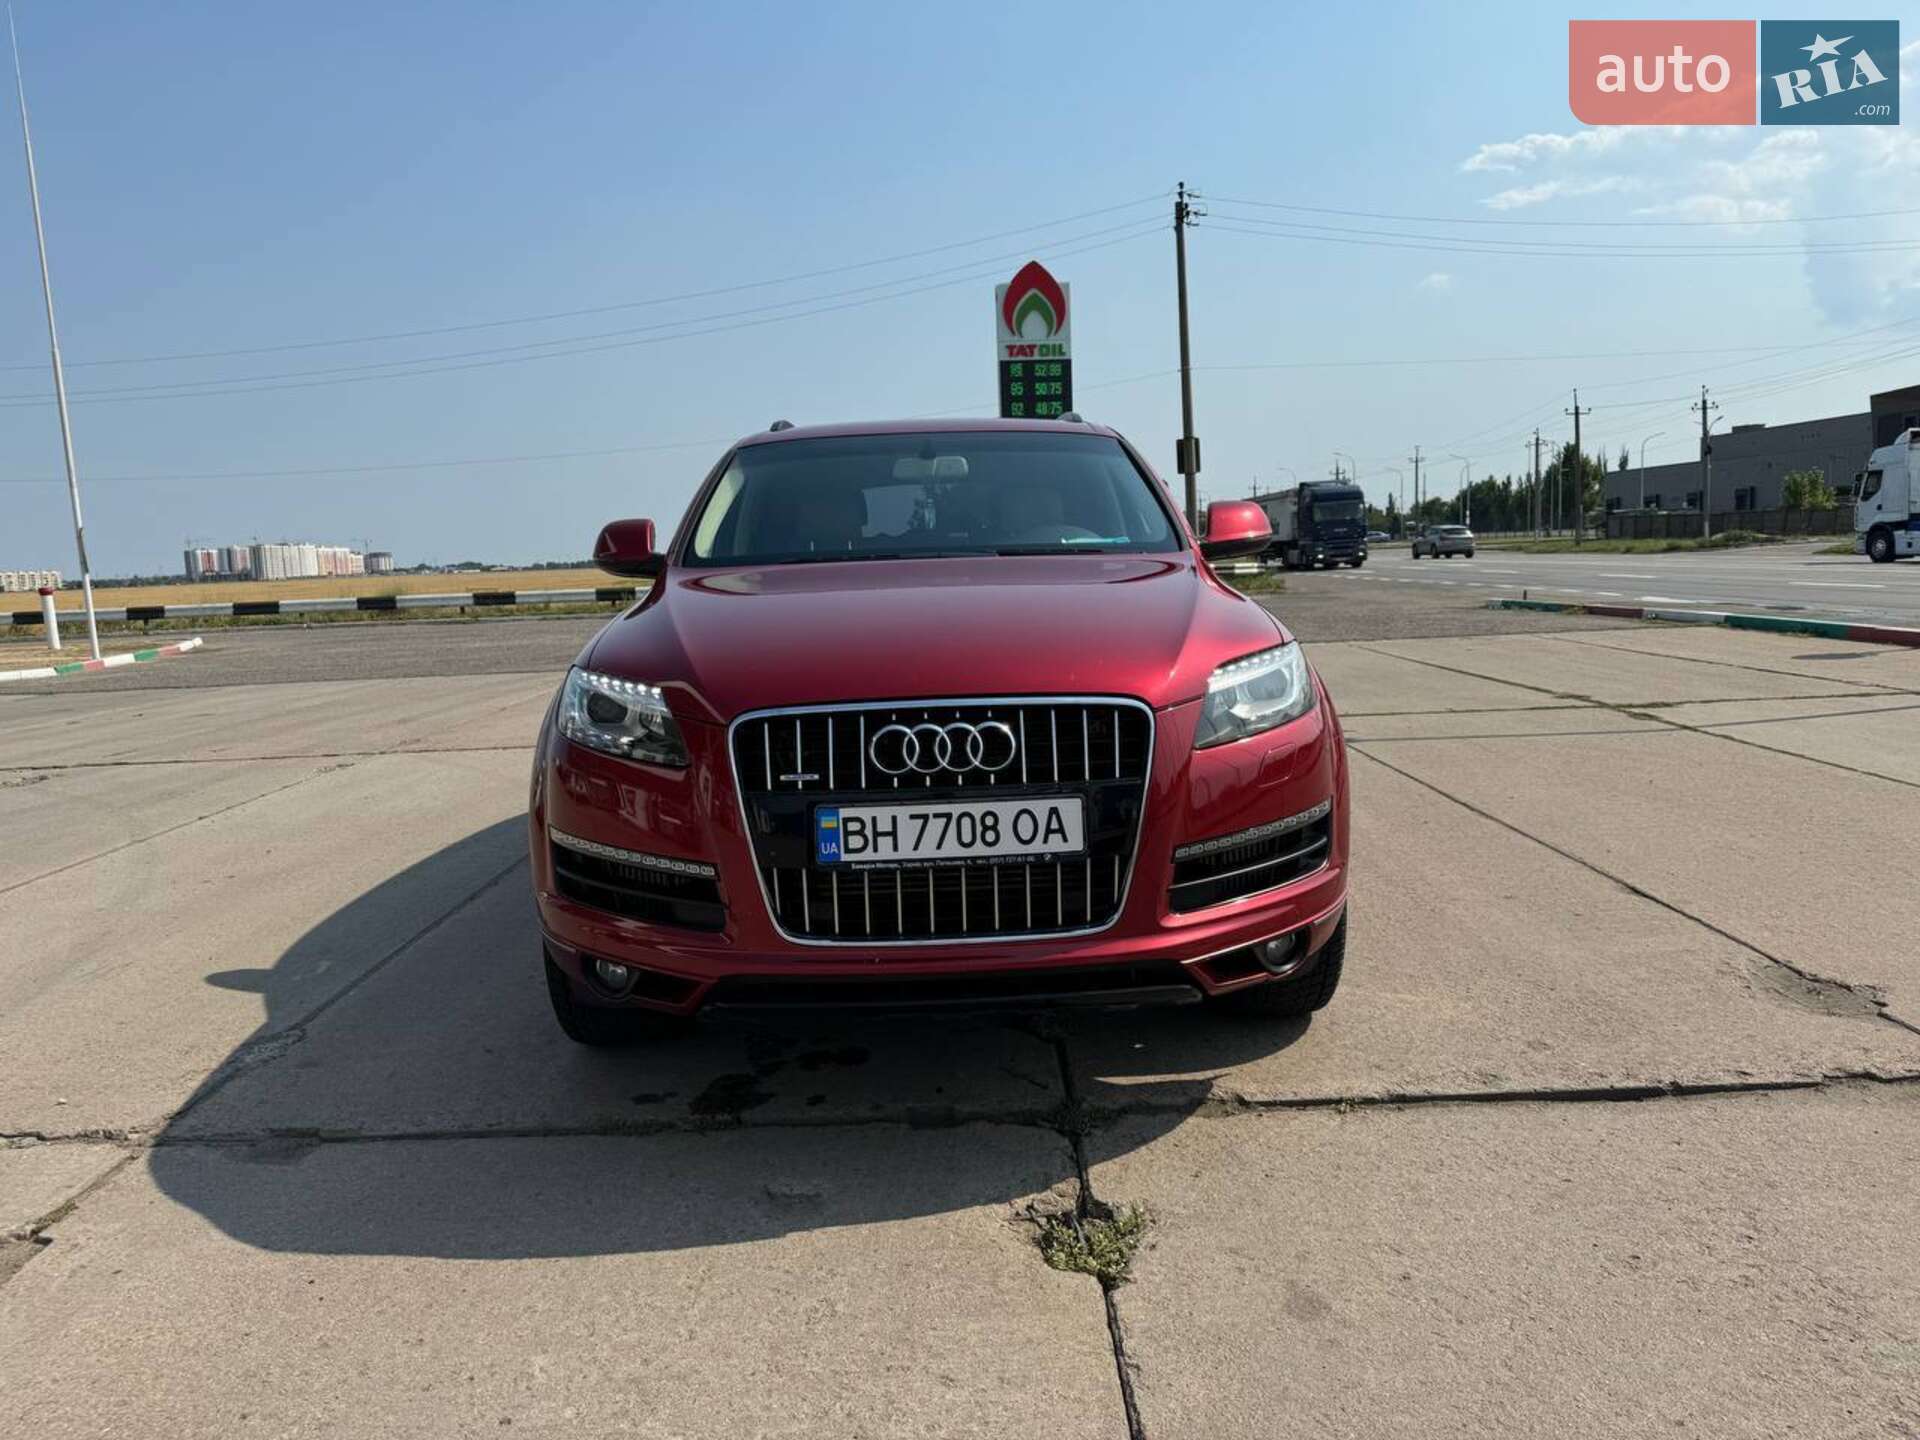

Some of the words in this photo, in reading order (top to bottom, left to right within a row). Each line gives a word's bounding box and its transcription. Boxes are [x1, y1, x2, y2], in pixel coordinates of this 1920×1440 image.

[842, 815, 899, 854] BH
[909, 810, 1001, 851] 7708
[1012, 806, 1068, 845] OA
[821, 843, 839, 855] UA
